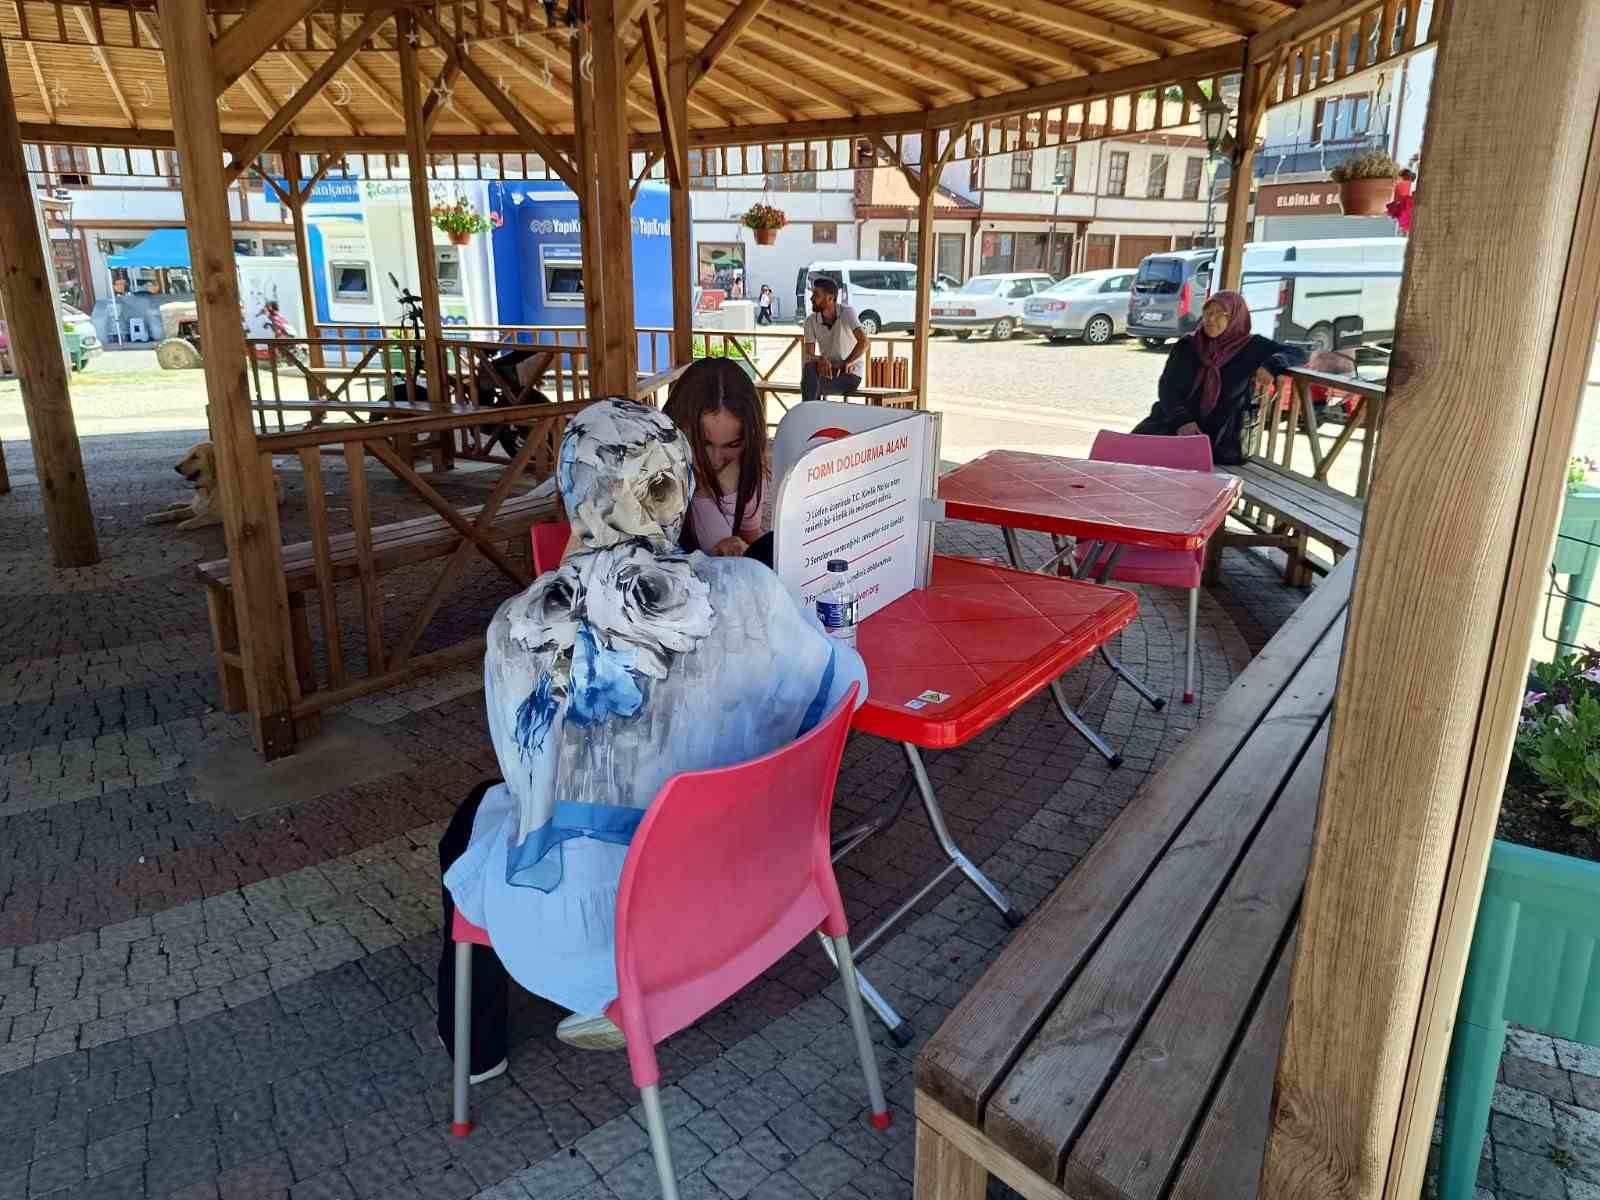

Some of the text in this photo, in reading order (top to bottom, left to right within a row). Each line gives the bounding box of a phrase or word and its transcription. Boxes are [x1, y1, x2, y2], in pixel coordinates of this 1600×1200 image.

[376, 182, 409, 195] Garant
[552, 218, 581, 235] YapıKr
[808, 461, 834, 482] FORM
[836, 445, 884, 472] DOLDURMA
